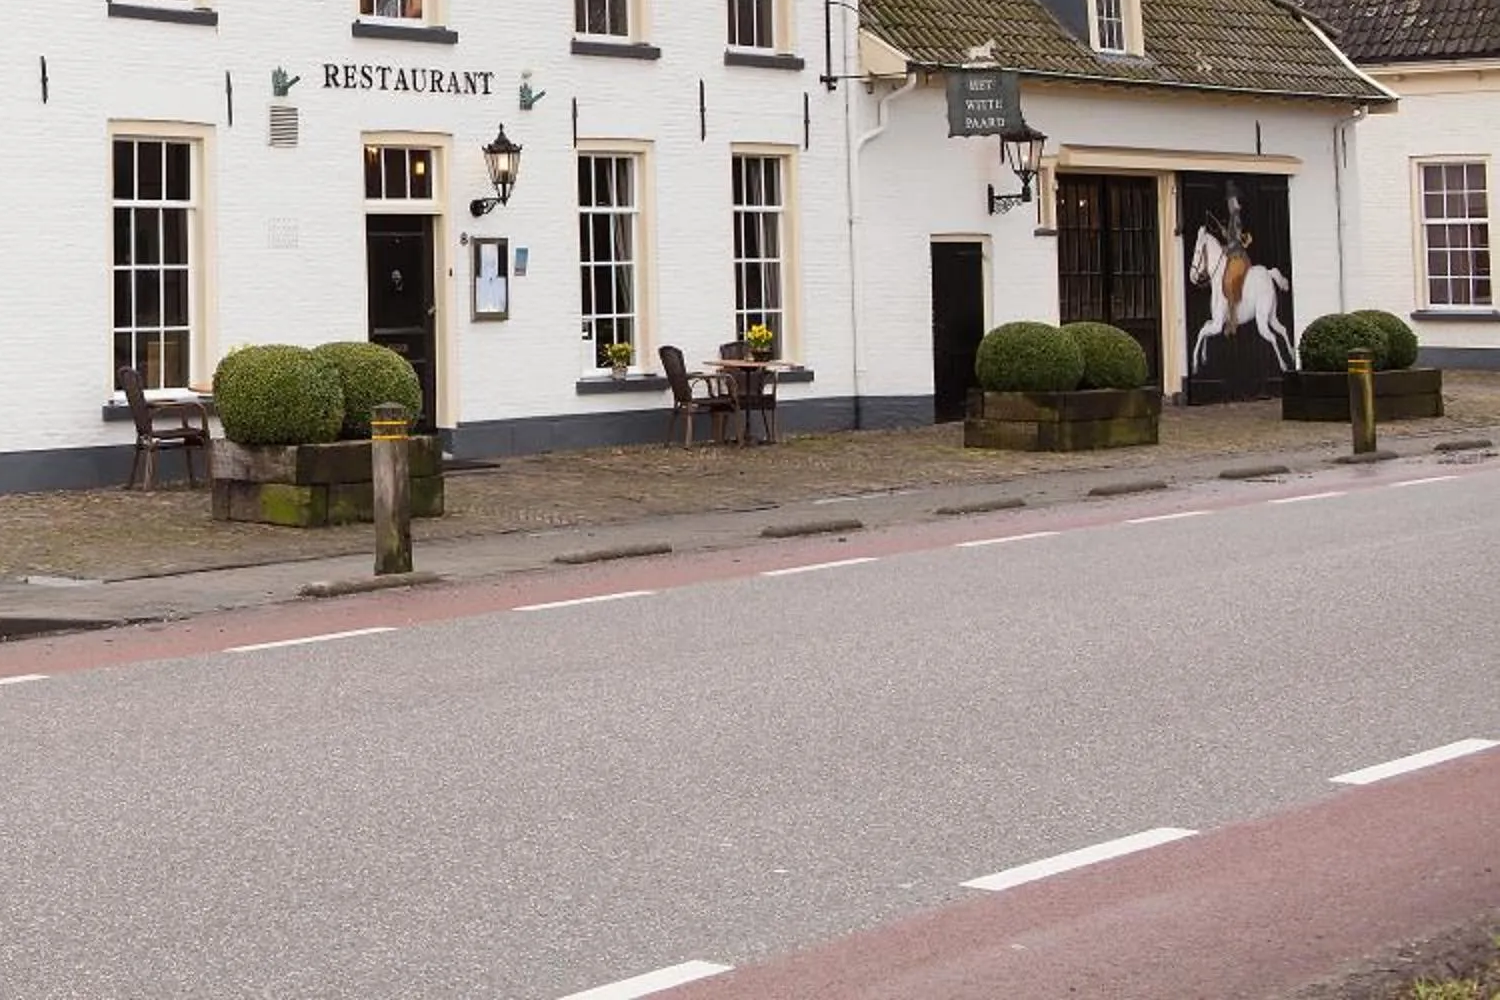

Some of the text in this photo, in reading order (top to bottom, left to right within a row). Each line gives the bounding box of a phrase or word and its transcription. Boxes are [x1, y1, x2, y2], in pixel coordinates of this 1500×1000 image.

[323, 63, 494, 96] RESTAURANT
[969, 79, 993, 91] HET
[965, 99, 1004, 111] WITTE
[965, 117, 1005, 129] PAARD
